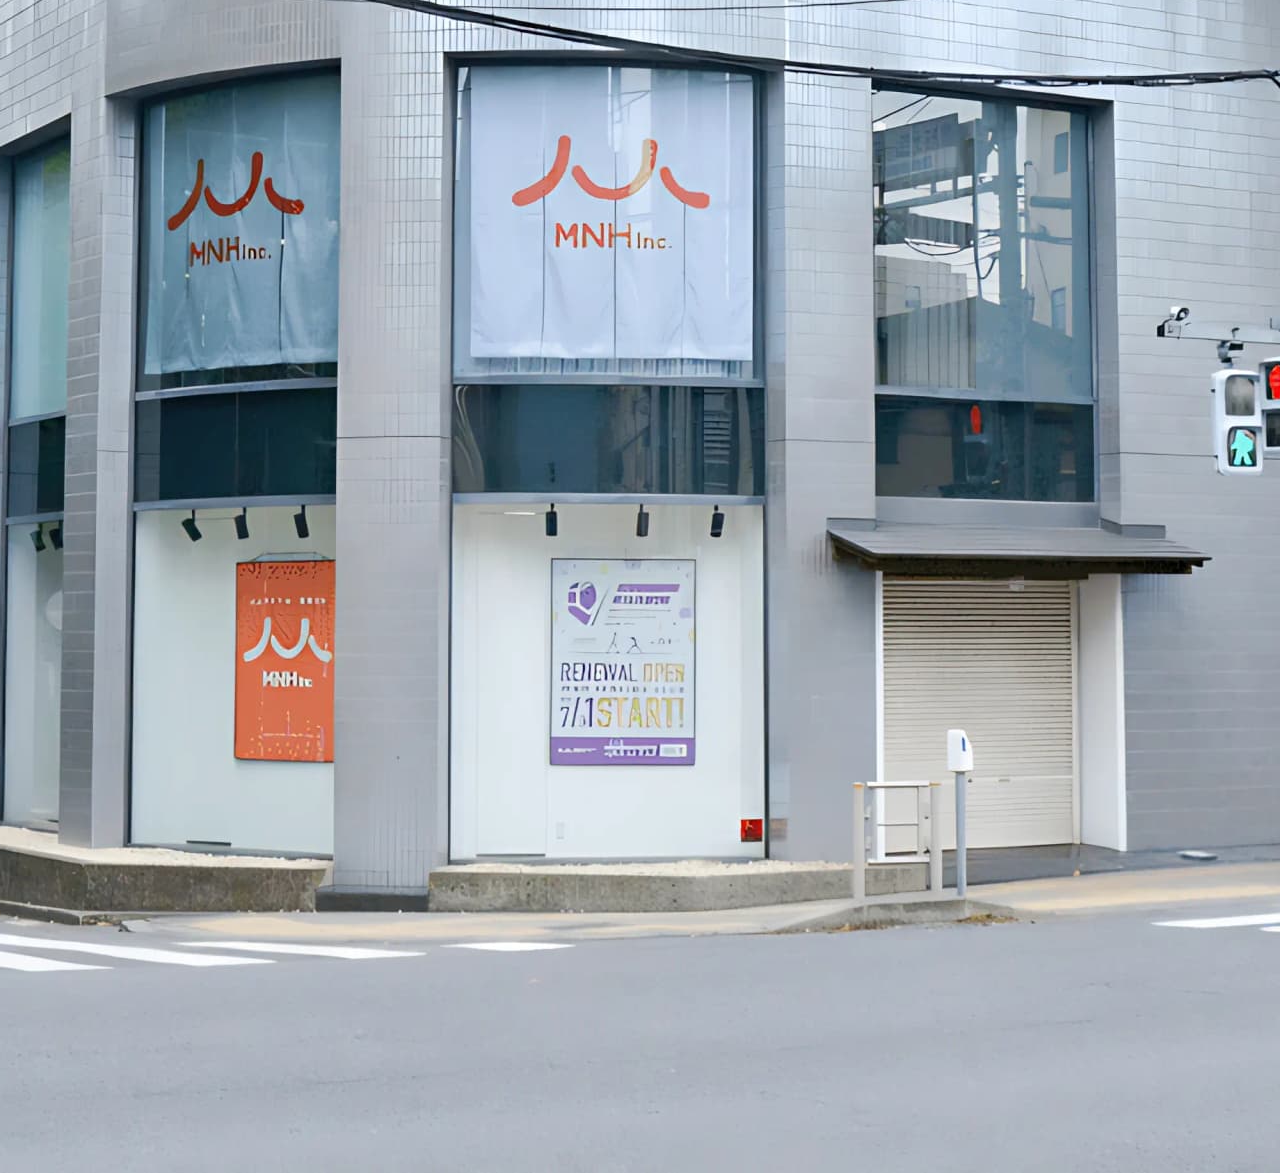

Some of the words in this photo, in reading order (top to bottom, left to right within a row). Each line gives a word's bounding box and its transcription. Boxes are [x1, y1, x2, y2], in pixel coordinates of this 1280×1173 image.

[554, 222, 632, 249] MNH
[636, 231, 673, 250] Inc.
[189, 235, 241, 268] MNH
[242, 243, 272, 260] Inc.
[560, 662, 638, 682] RENEWAL
[643, 662, 686, 683] OPEN
[596, 696, 685, 728] START!
